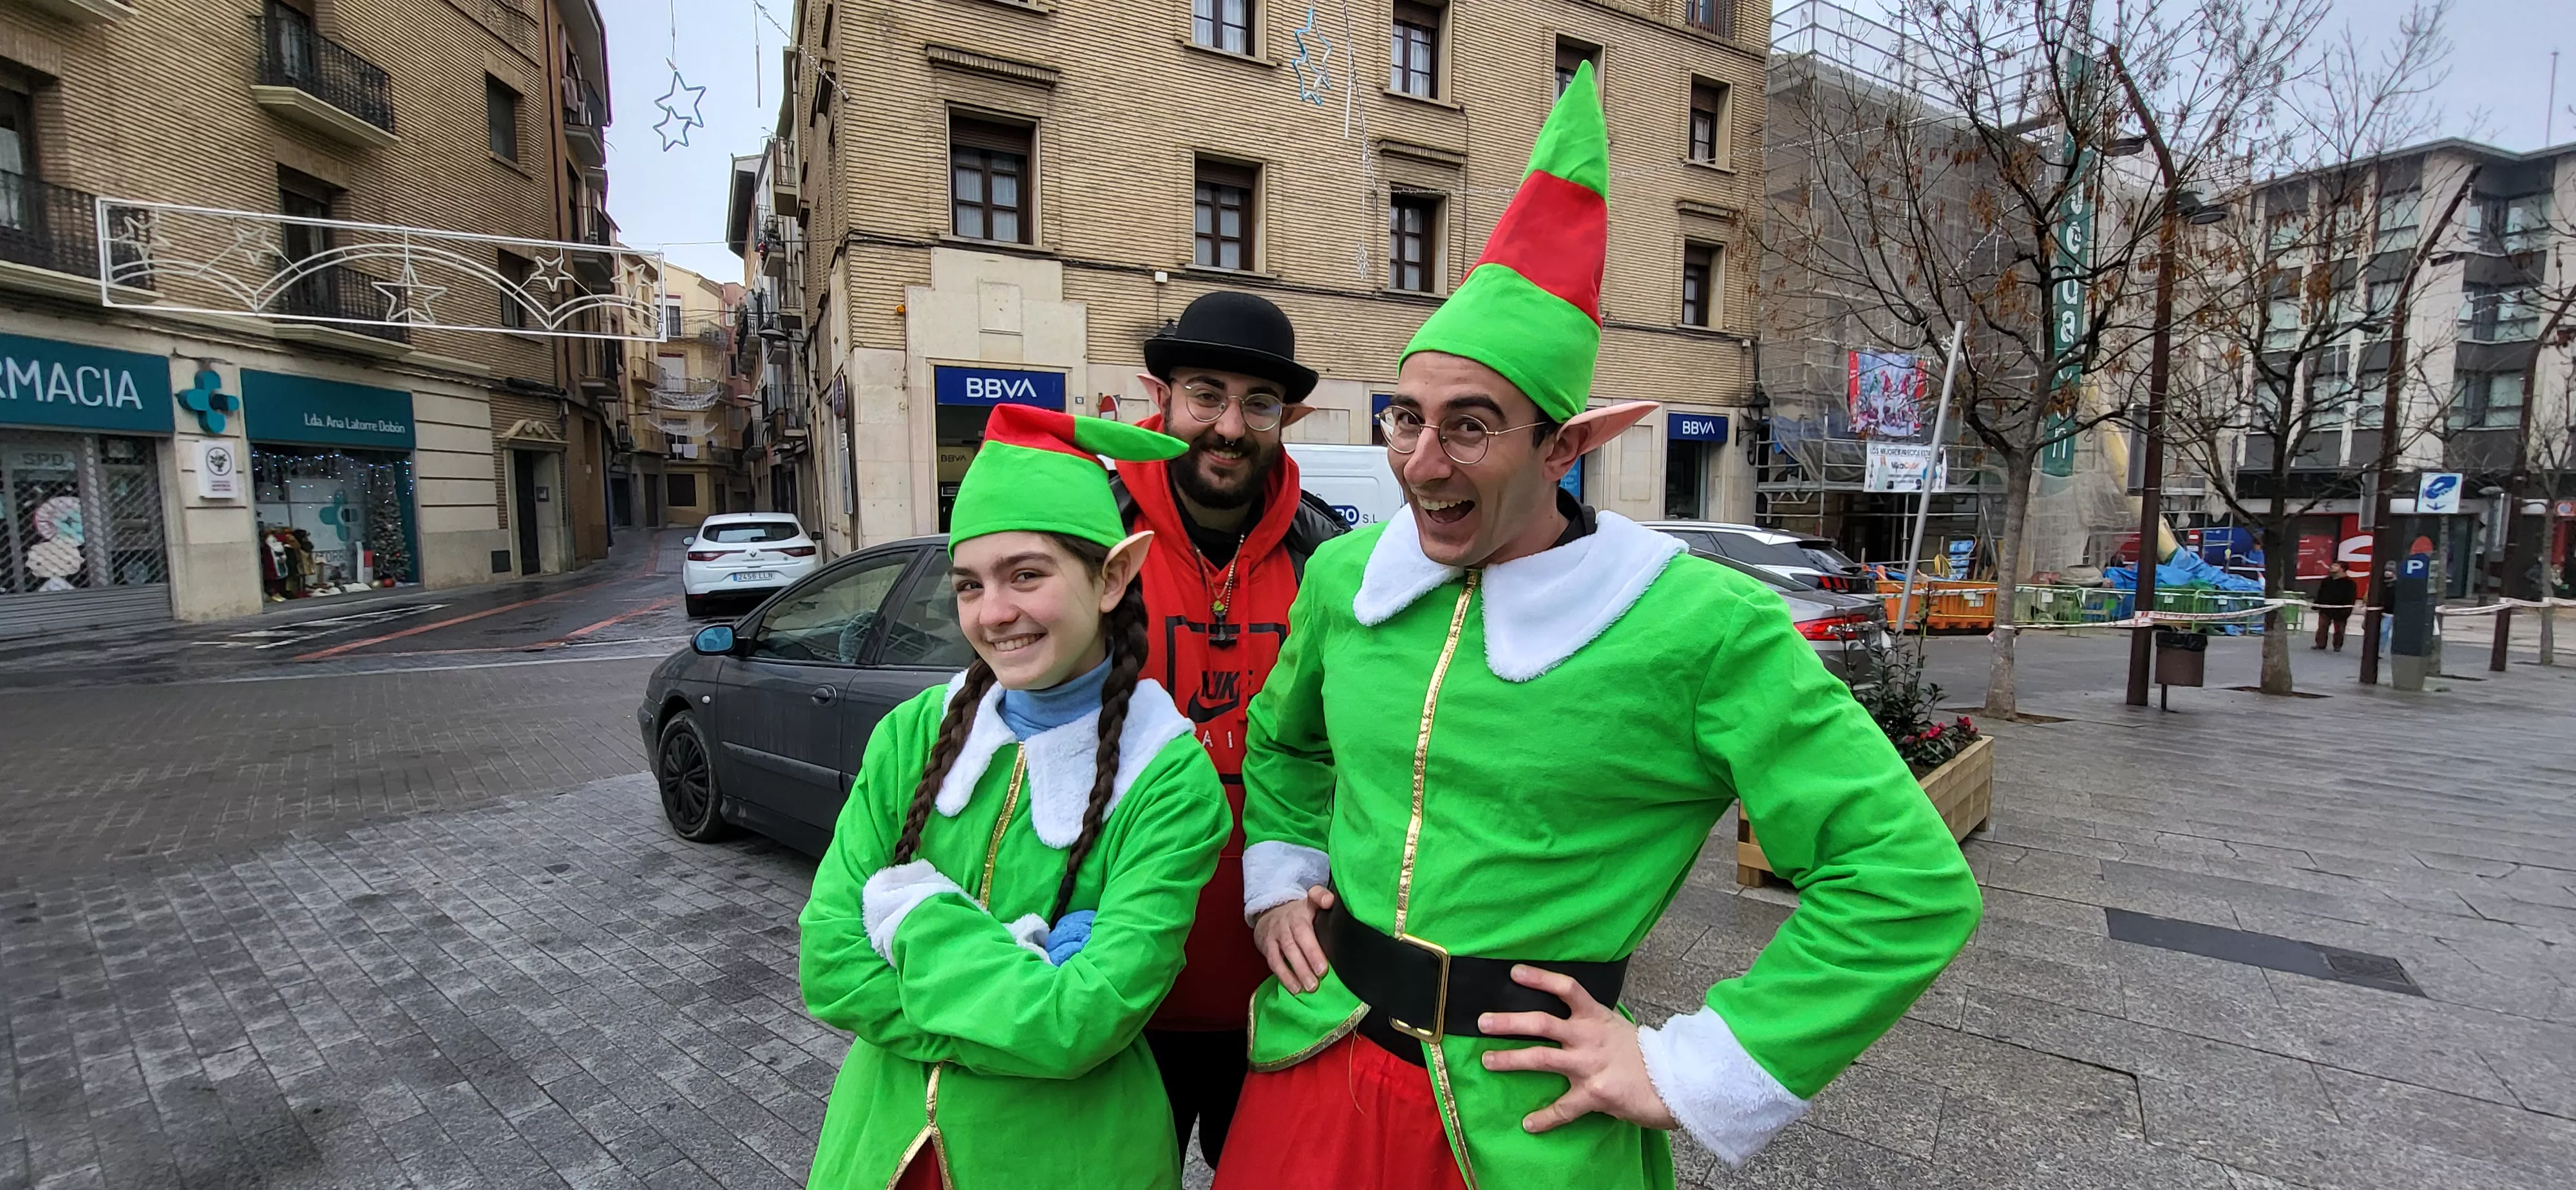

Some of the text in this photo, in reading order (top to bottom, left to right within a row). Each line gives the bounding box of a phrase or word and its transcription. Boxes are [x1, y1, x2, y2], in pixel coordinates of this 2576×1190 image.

[966, 377, 1037, 399] BBVA
[304, 412, 406, 433] Lda. Ana Latorre Dobón
[1682, 420, 1715, 435] BBVA
[2407, 560, 2423, 574] P
[1200, 670, 1253, 699] NIK
